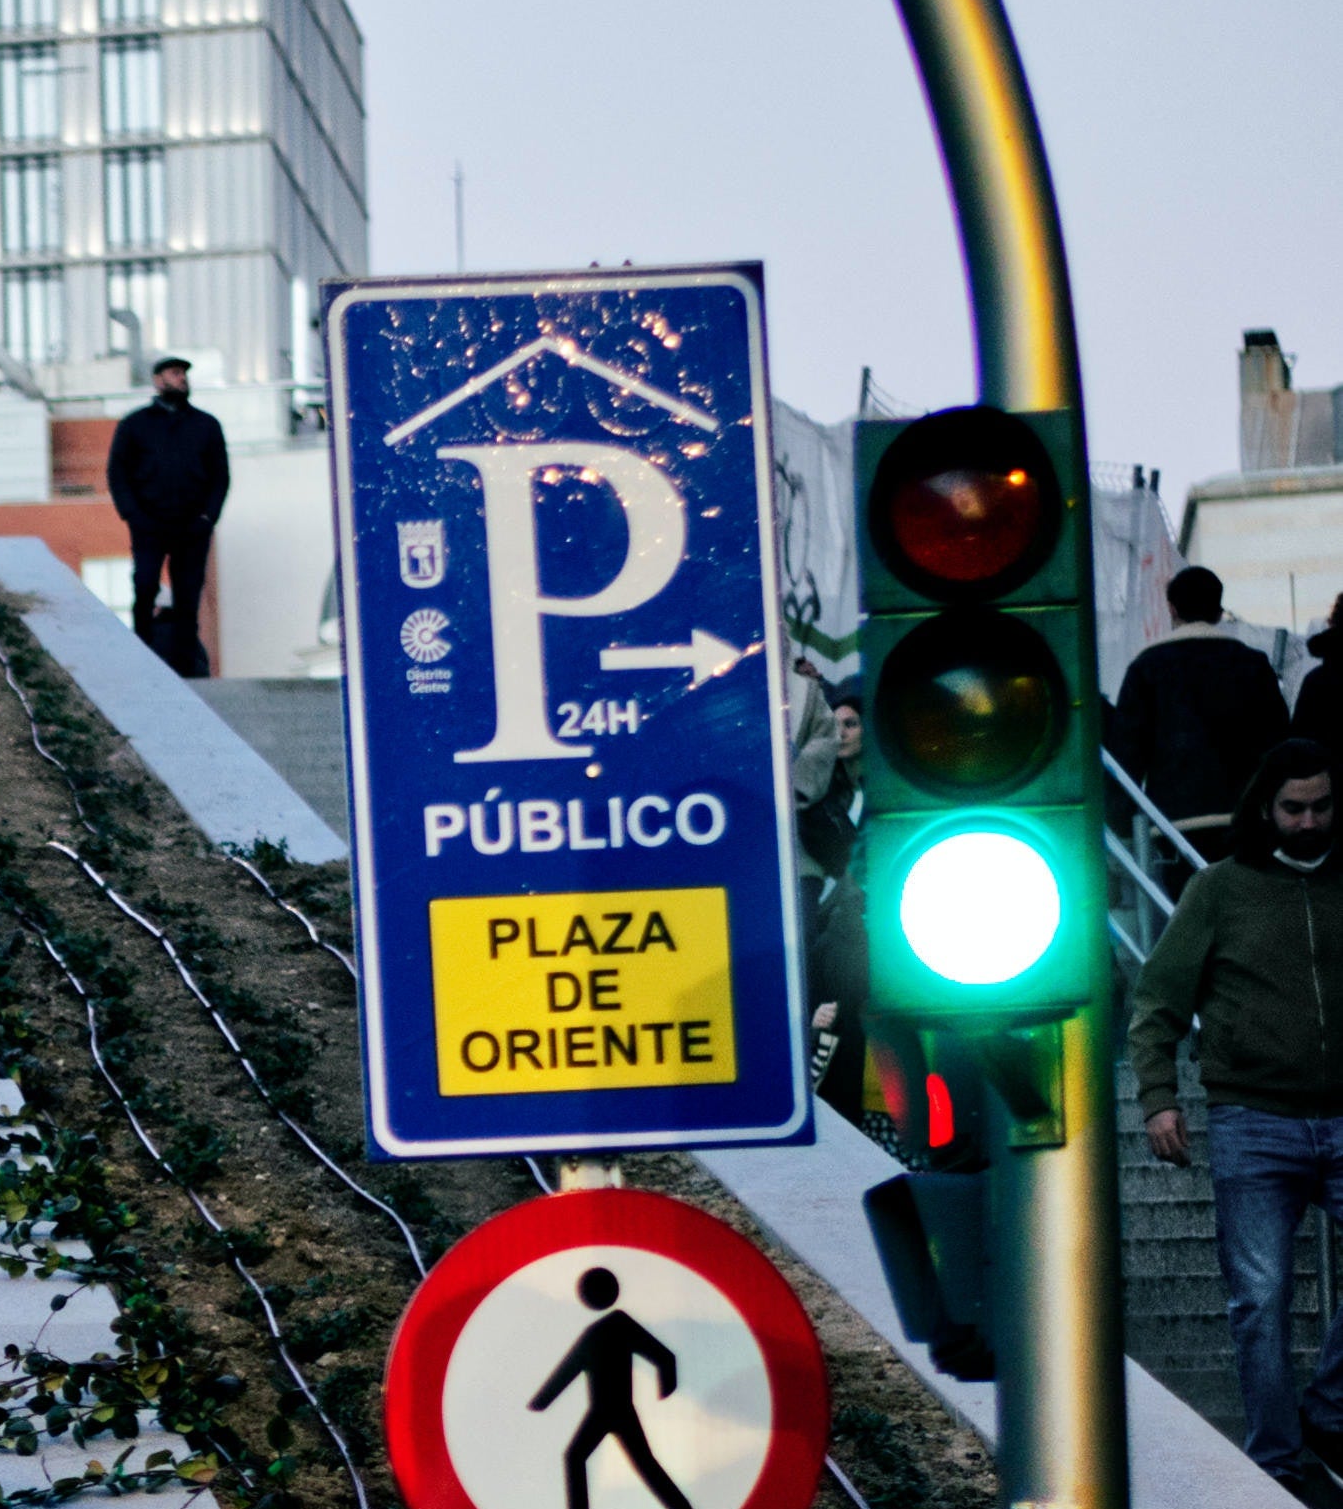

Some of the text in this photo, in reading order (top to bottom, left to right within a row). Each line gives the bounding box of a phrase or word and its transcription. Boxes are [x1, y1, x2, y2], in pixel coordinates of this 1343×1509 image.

[437, 442, 687, 763] P
[557, 699, 638, 737] 24H
[424, 787, 726, 857] PÚBLICO
[488, 911, 677, 960] PLAZA
[547, 969, 621, 1013] DE
[460, 1021, 713, 1073] ORIENTE
